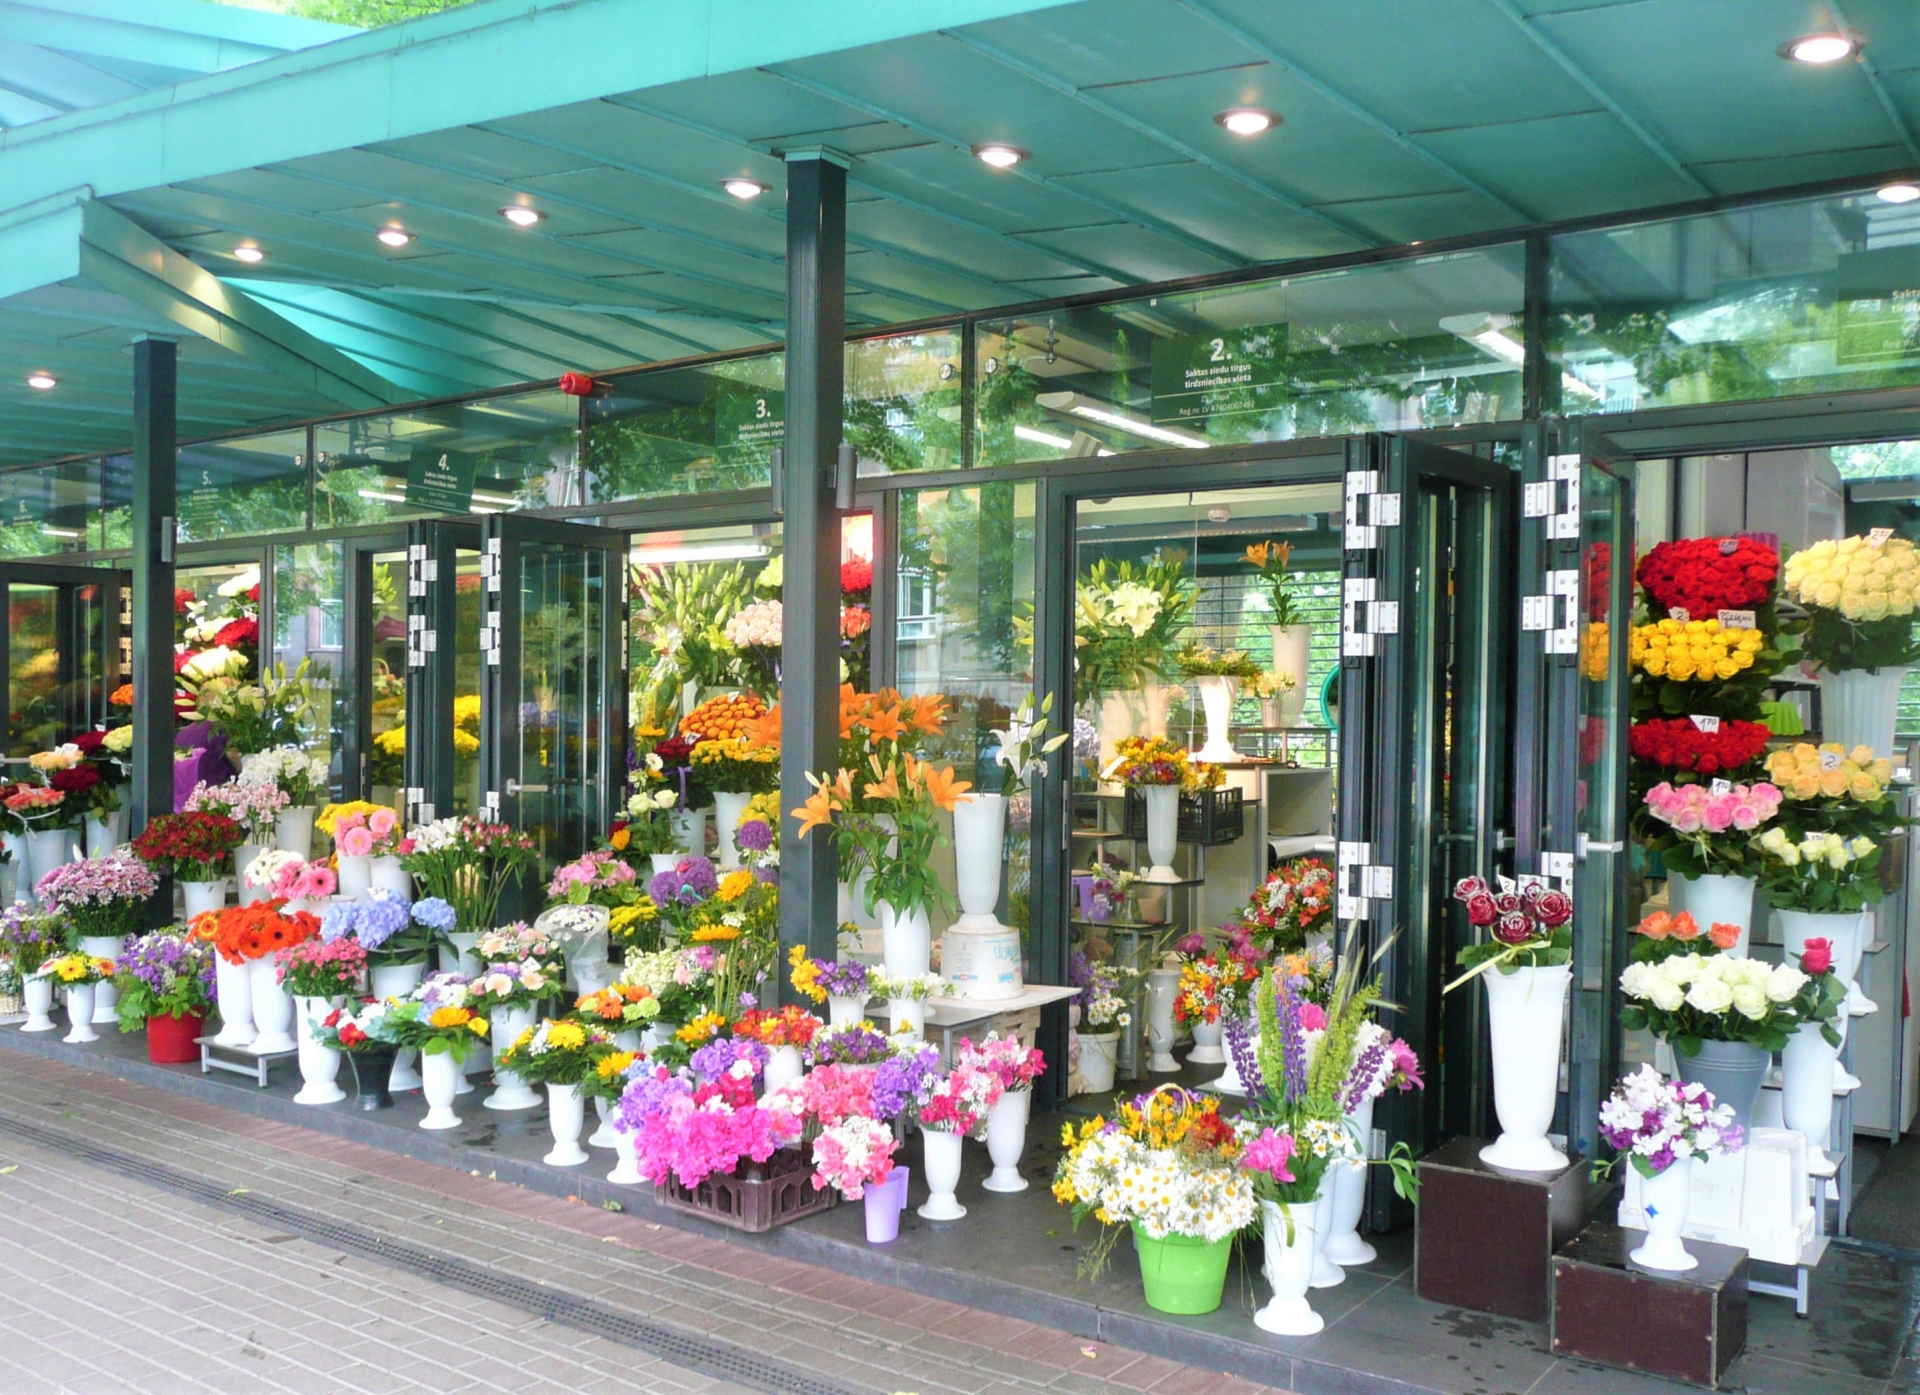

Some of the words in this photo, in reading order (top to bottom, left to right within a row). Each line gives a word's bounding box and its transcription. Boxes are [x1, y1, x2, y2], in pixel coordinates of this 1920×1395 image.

[1210, 338, 1232, 361] 2.
[1185, 369, 1208, 378] Saktas
[1209, 365, 1229, 375] ziedu
[1230, 363, 1251, 373] tirgus
[1232, 374, 1251, 382] vieta
[756, 398, 771, 418] 3.
[438, 453, 450, 471] 4.
[202, 471, 212, 485] 5.
